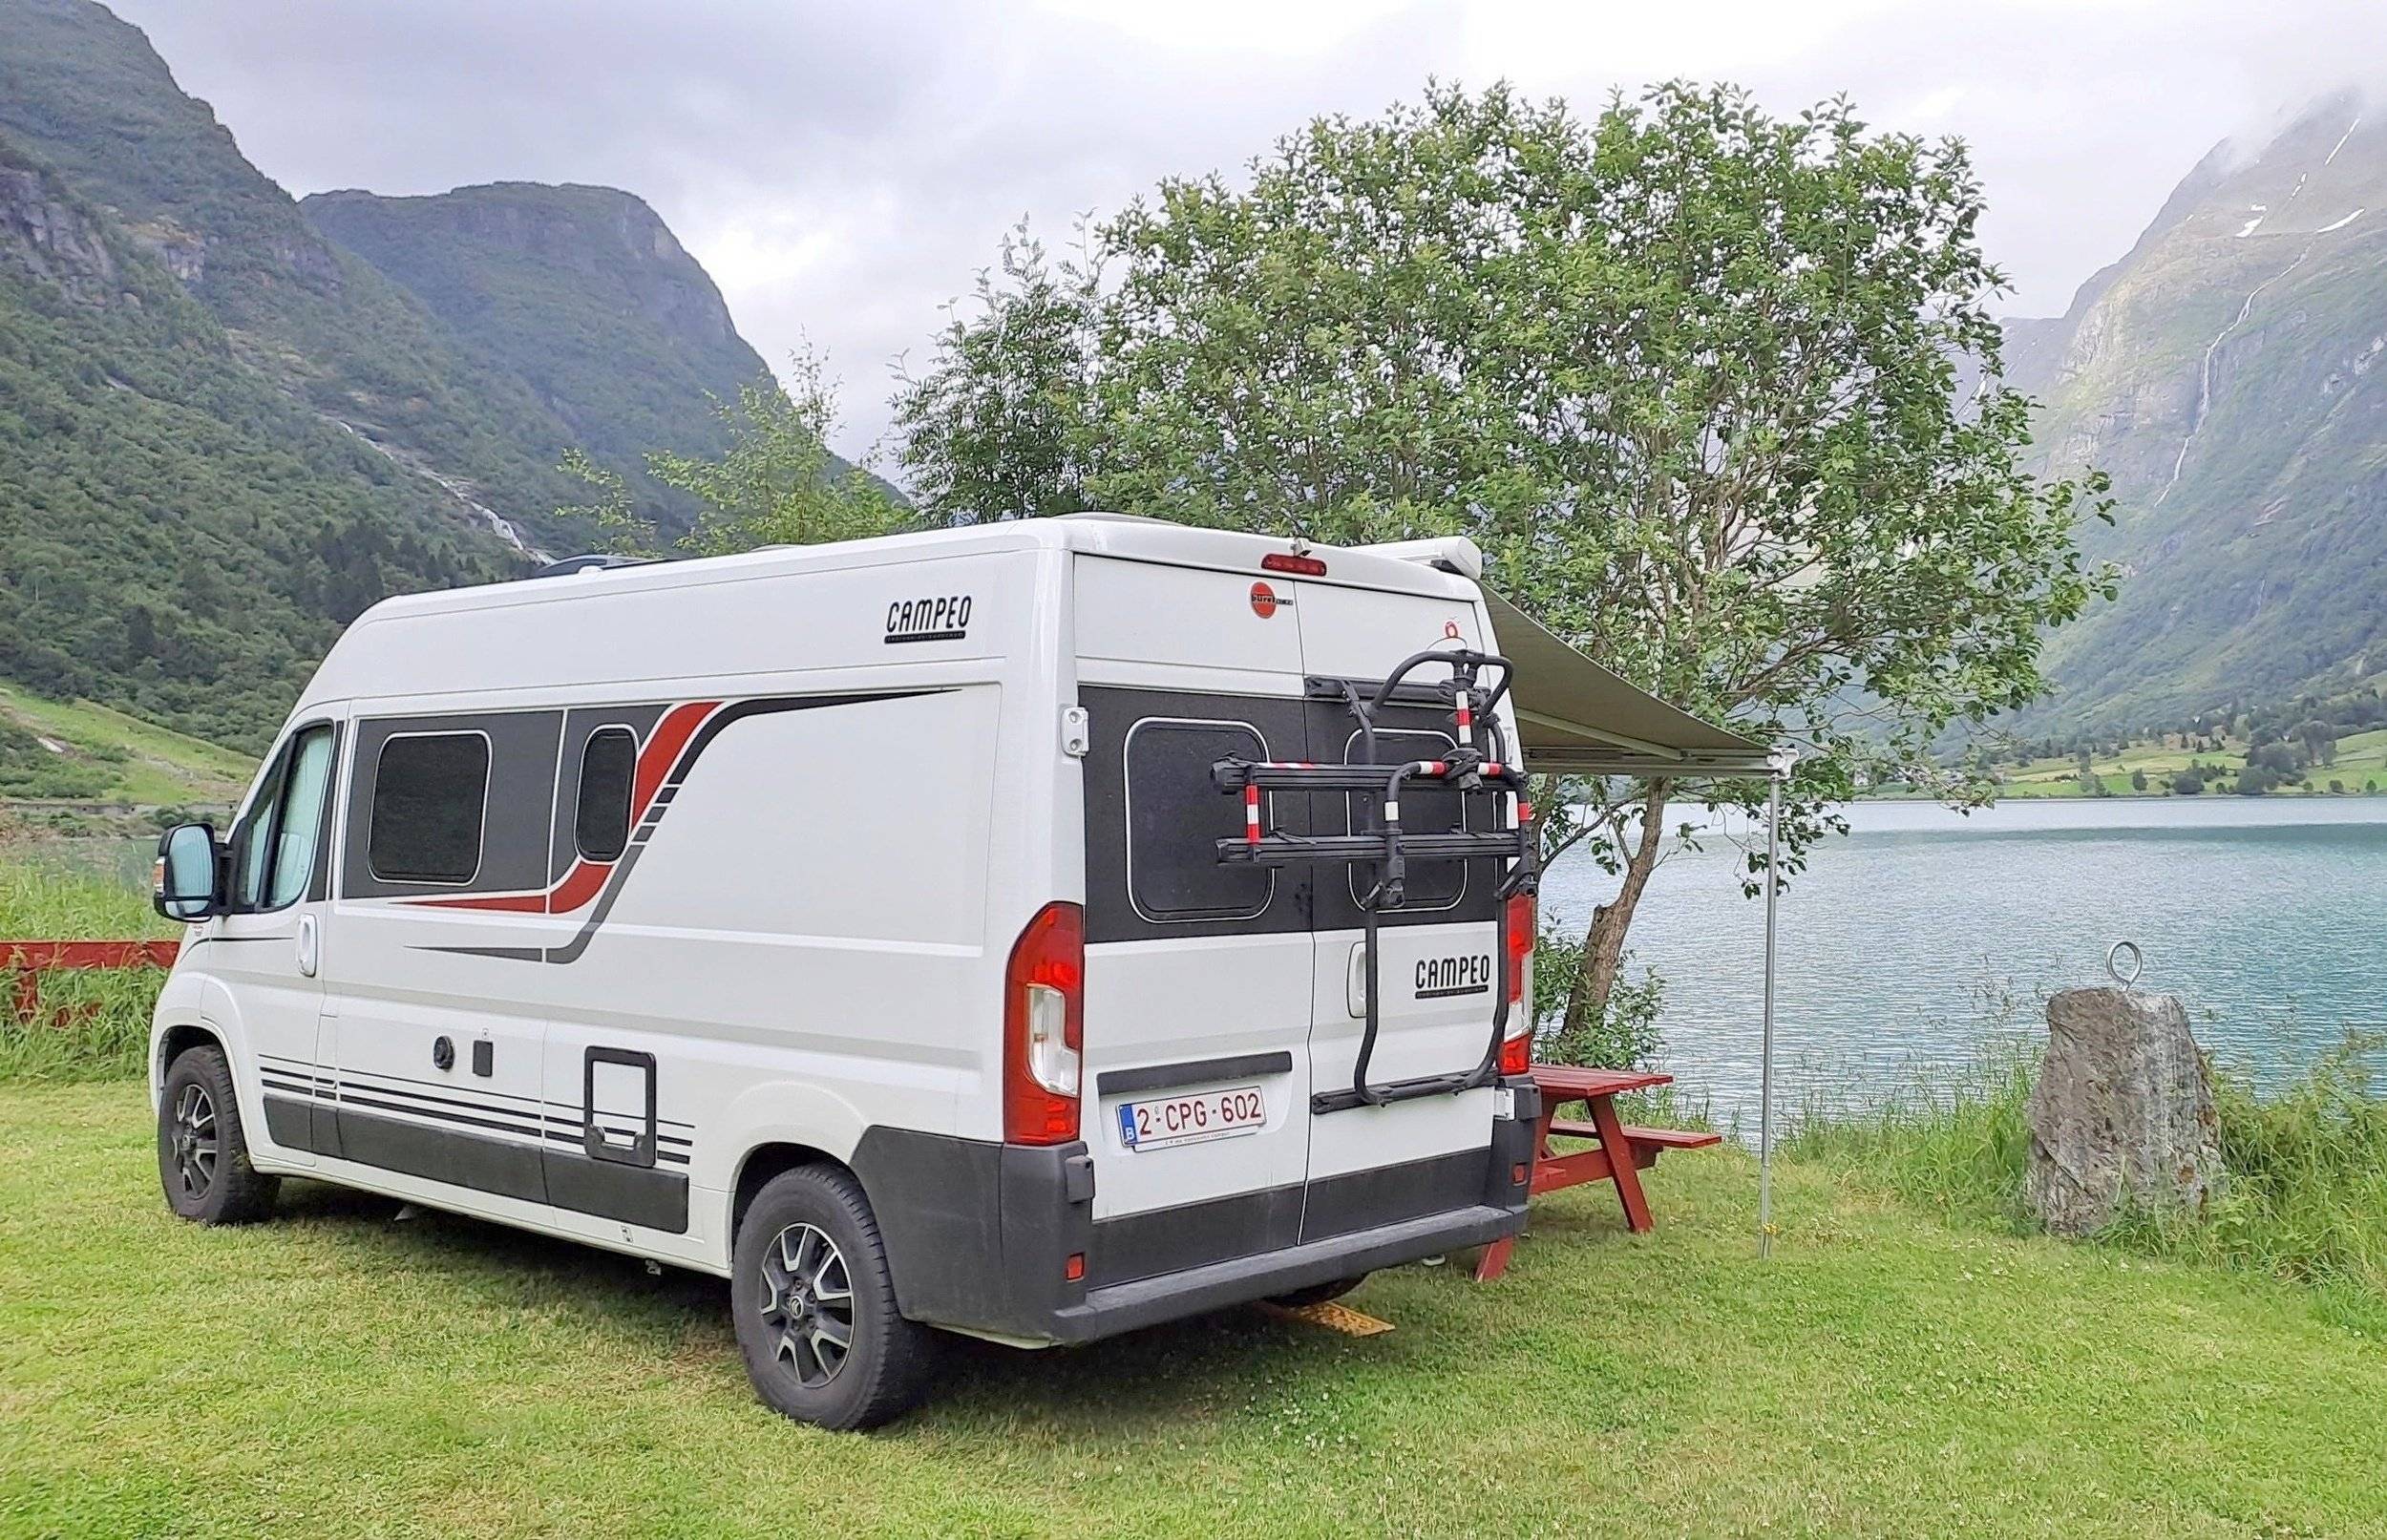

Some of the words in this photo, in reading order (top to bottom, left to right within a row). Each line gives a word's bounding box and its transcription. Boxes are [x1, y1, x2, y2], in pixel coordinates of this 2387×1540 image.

[886, 596, 972, 632] CAMPEO
[1415, 955, 1489, 989] CAMPEO
[1125, 1128, 1135, 1140] B
